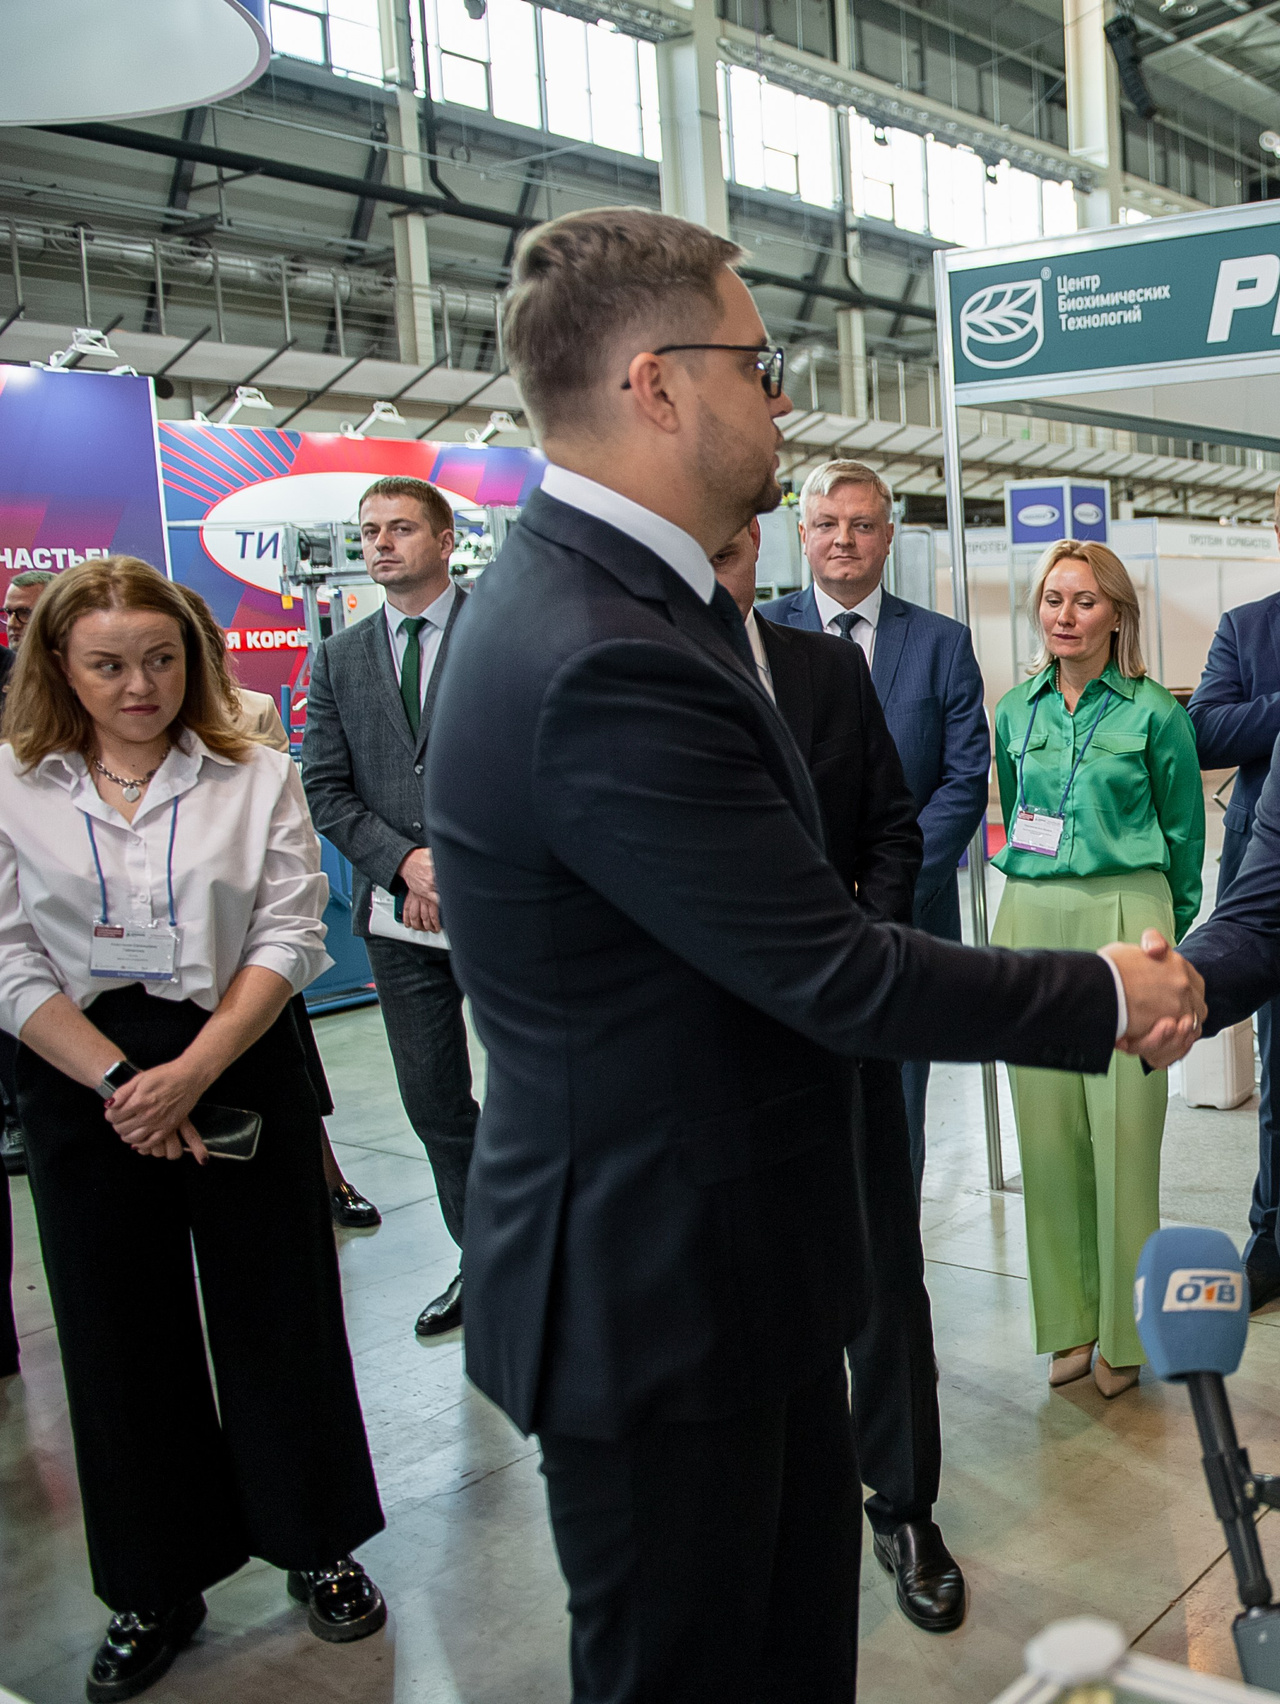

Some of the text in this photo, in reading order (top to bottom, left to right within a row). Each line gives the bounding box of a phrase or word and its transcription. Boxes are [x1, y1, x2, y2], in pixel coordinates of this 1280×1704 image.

[1056, 274, 1101, 294] Центр
[1057, 283, 1171, 313] Биохимических
[1058, 305, 1142, 332] Технологий
[246, 631, 308, 649] КОРО
